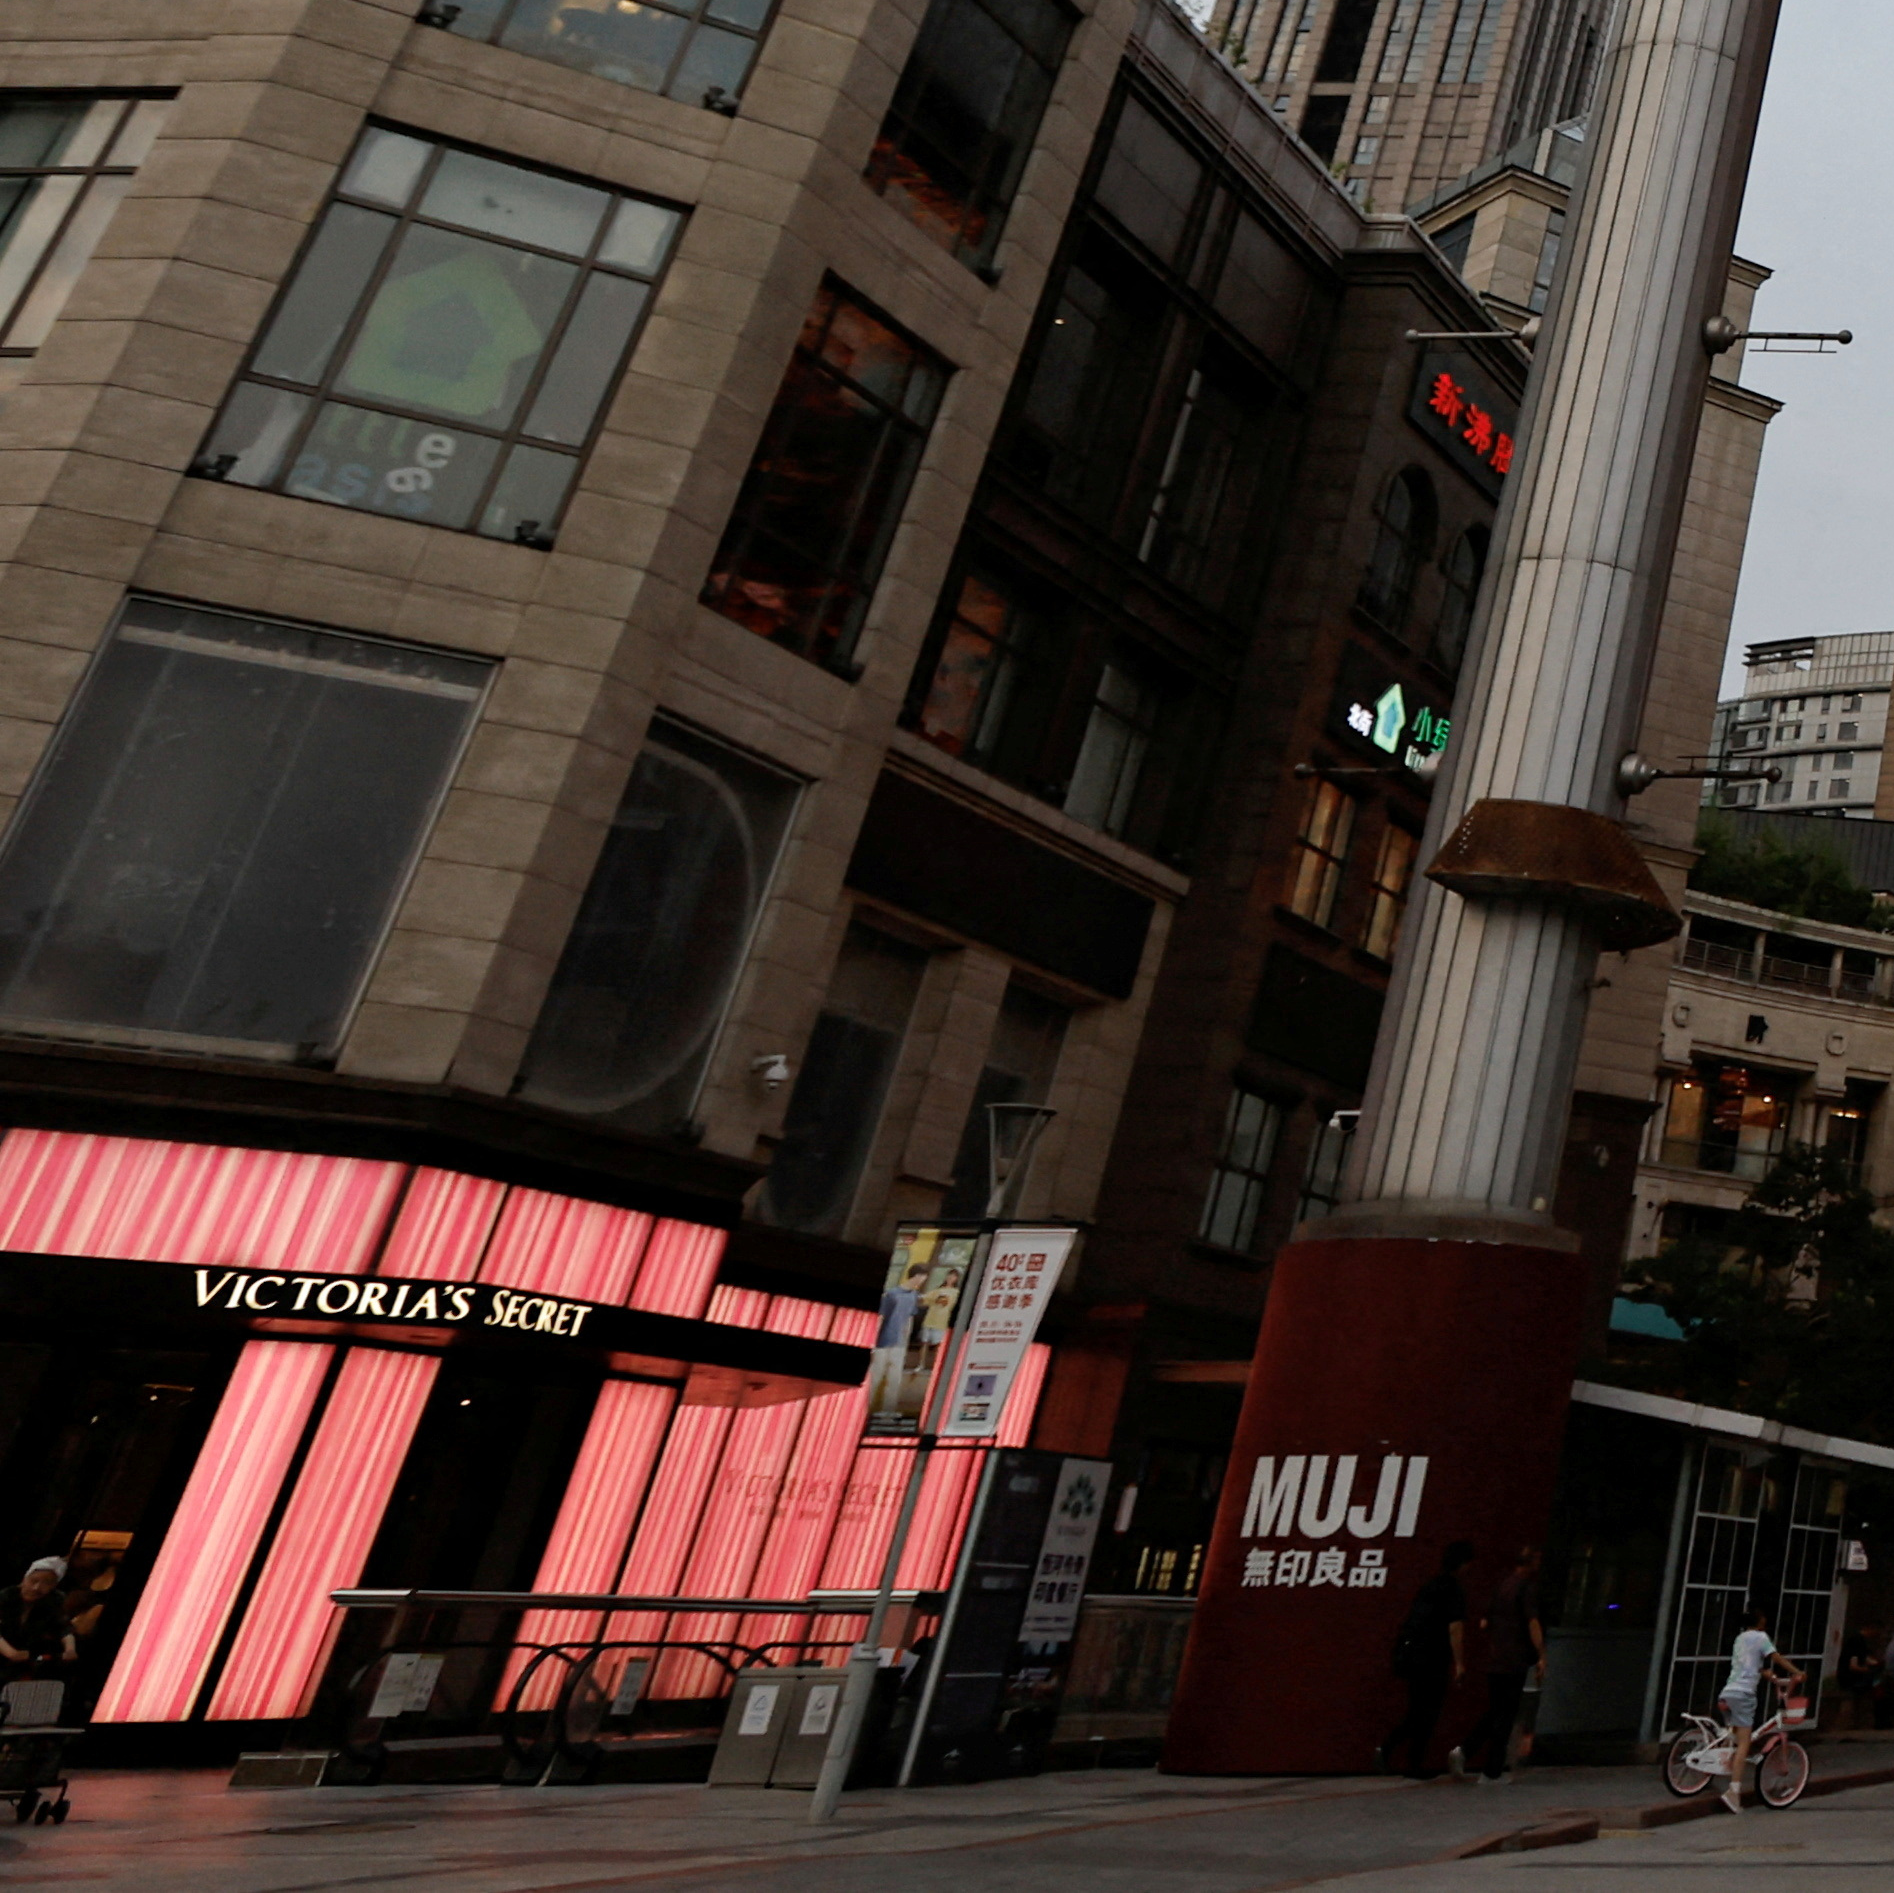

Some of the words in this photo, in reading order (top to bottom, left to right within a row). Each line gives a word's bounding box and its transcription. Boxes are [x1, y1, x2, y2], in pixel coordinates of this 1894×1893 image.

[194, 1269, 475, 1320] VICTORIA'S
[484, 1289, 592, 1336] SECRET
[1240, 1452, 1430, 1539] MUJI
[1241, 1546, 1388, 1588] 無印良品
